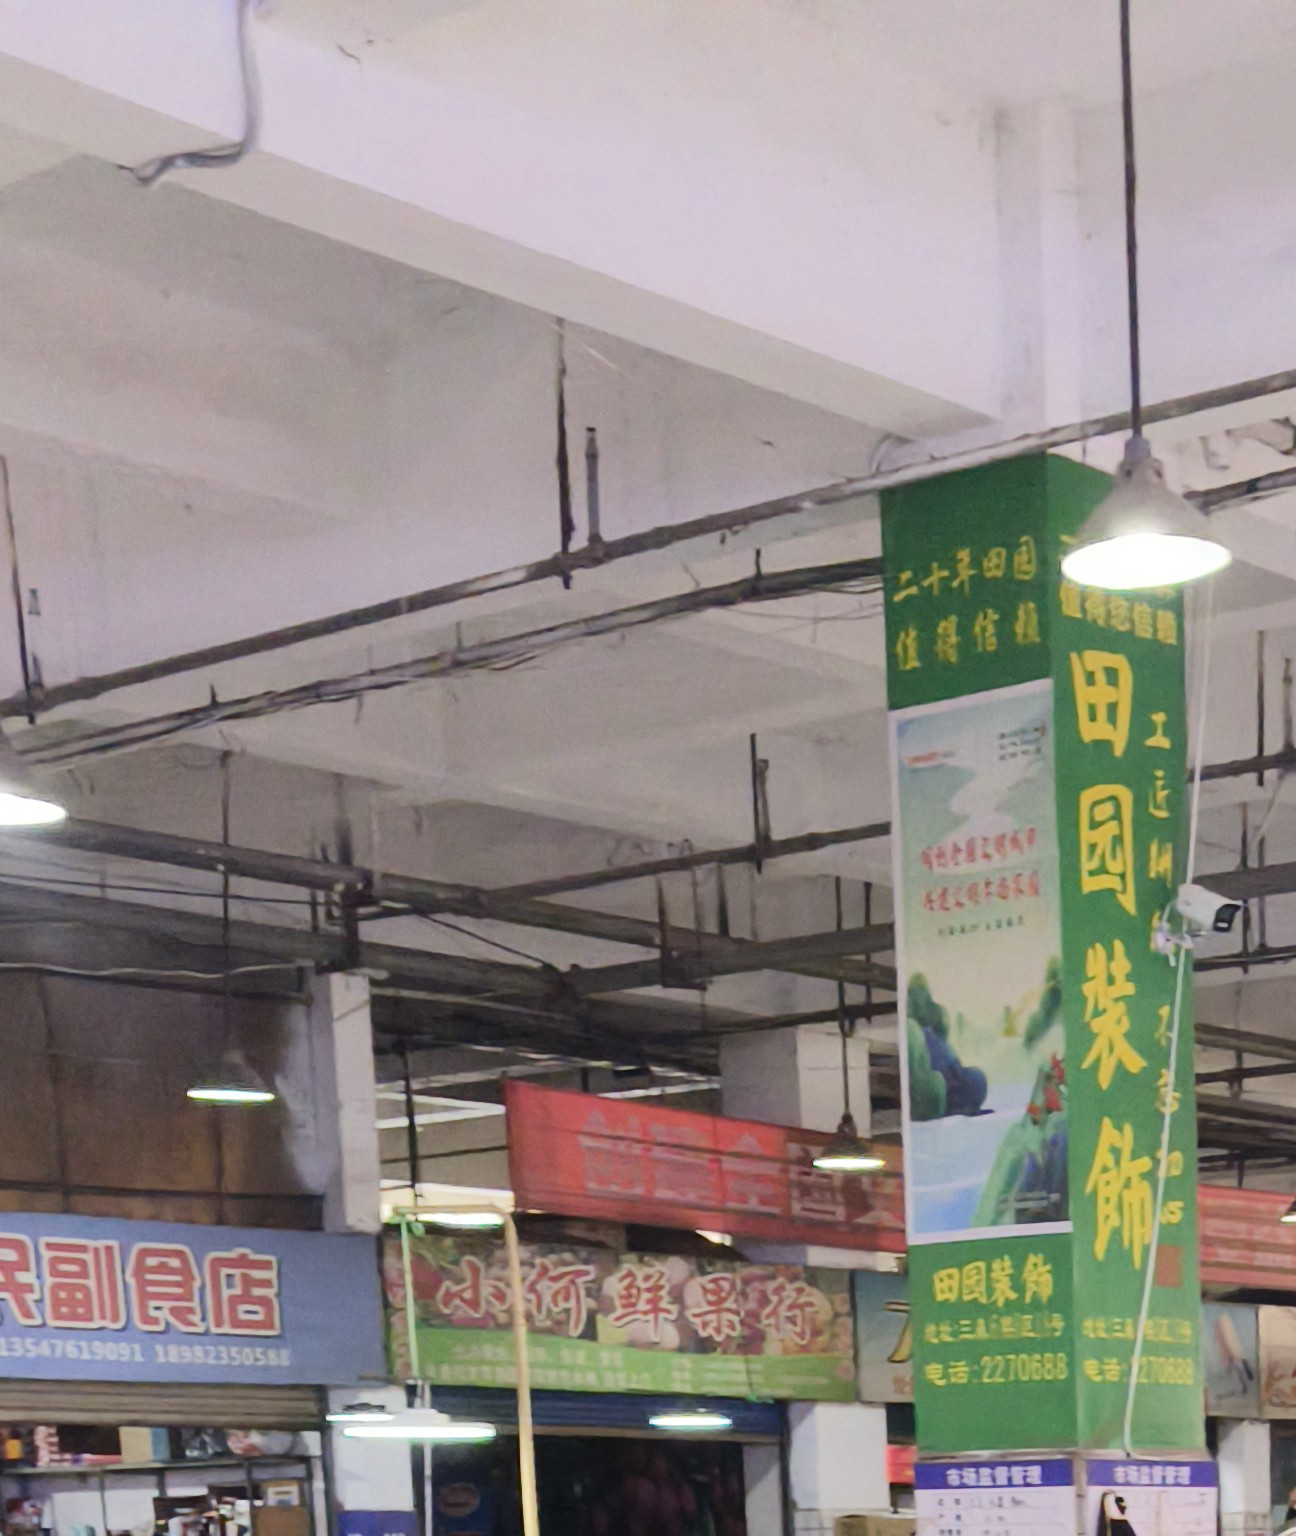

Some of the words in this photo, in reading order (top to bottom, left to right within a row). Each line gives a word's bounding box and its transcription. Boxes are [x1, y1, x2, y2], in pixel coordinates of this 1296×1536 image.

[437, 1254, 820, 1345] 小何鲜果行
